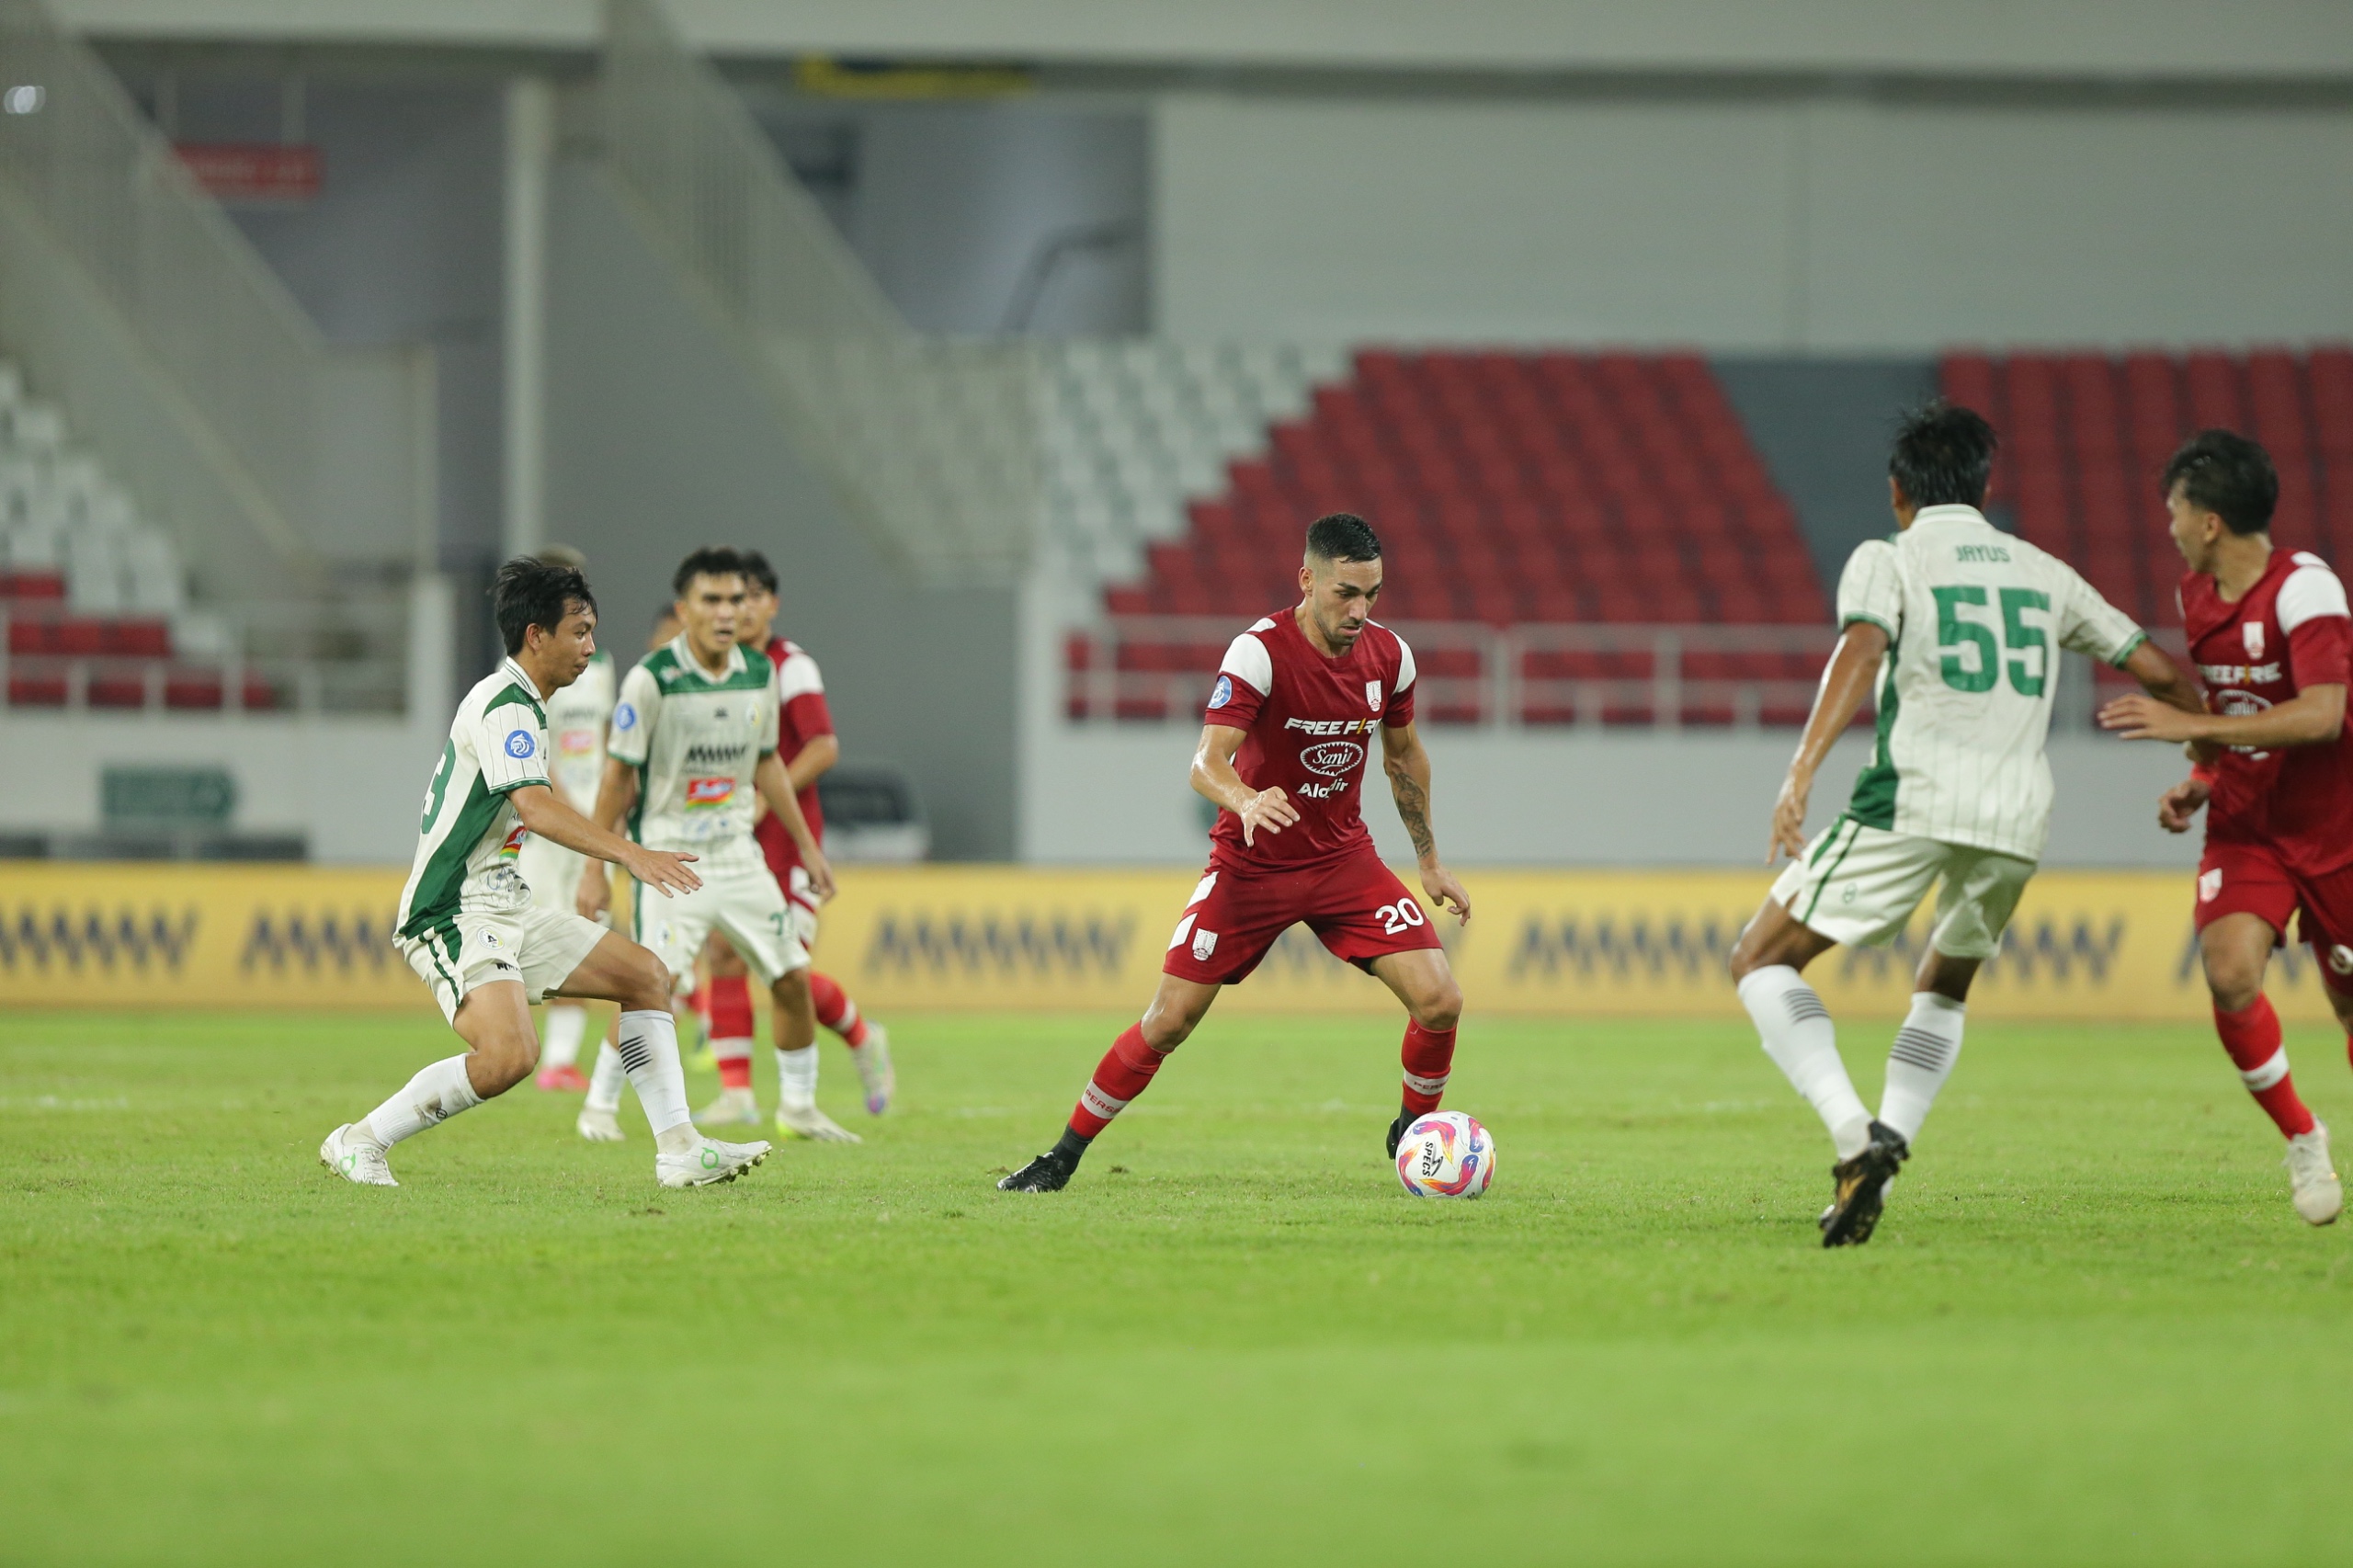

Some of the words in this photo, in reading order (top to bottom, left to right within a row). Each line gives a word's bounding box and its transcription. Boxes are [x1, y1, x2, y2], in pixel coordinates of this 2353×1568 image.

[1929, 585, 2051, 699] 55
[1284, 717, 1344, 735] FREE
[1374, 896, 1425, 936] 20
[1422, 1141, 1434, 1177] SPECS
